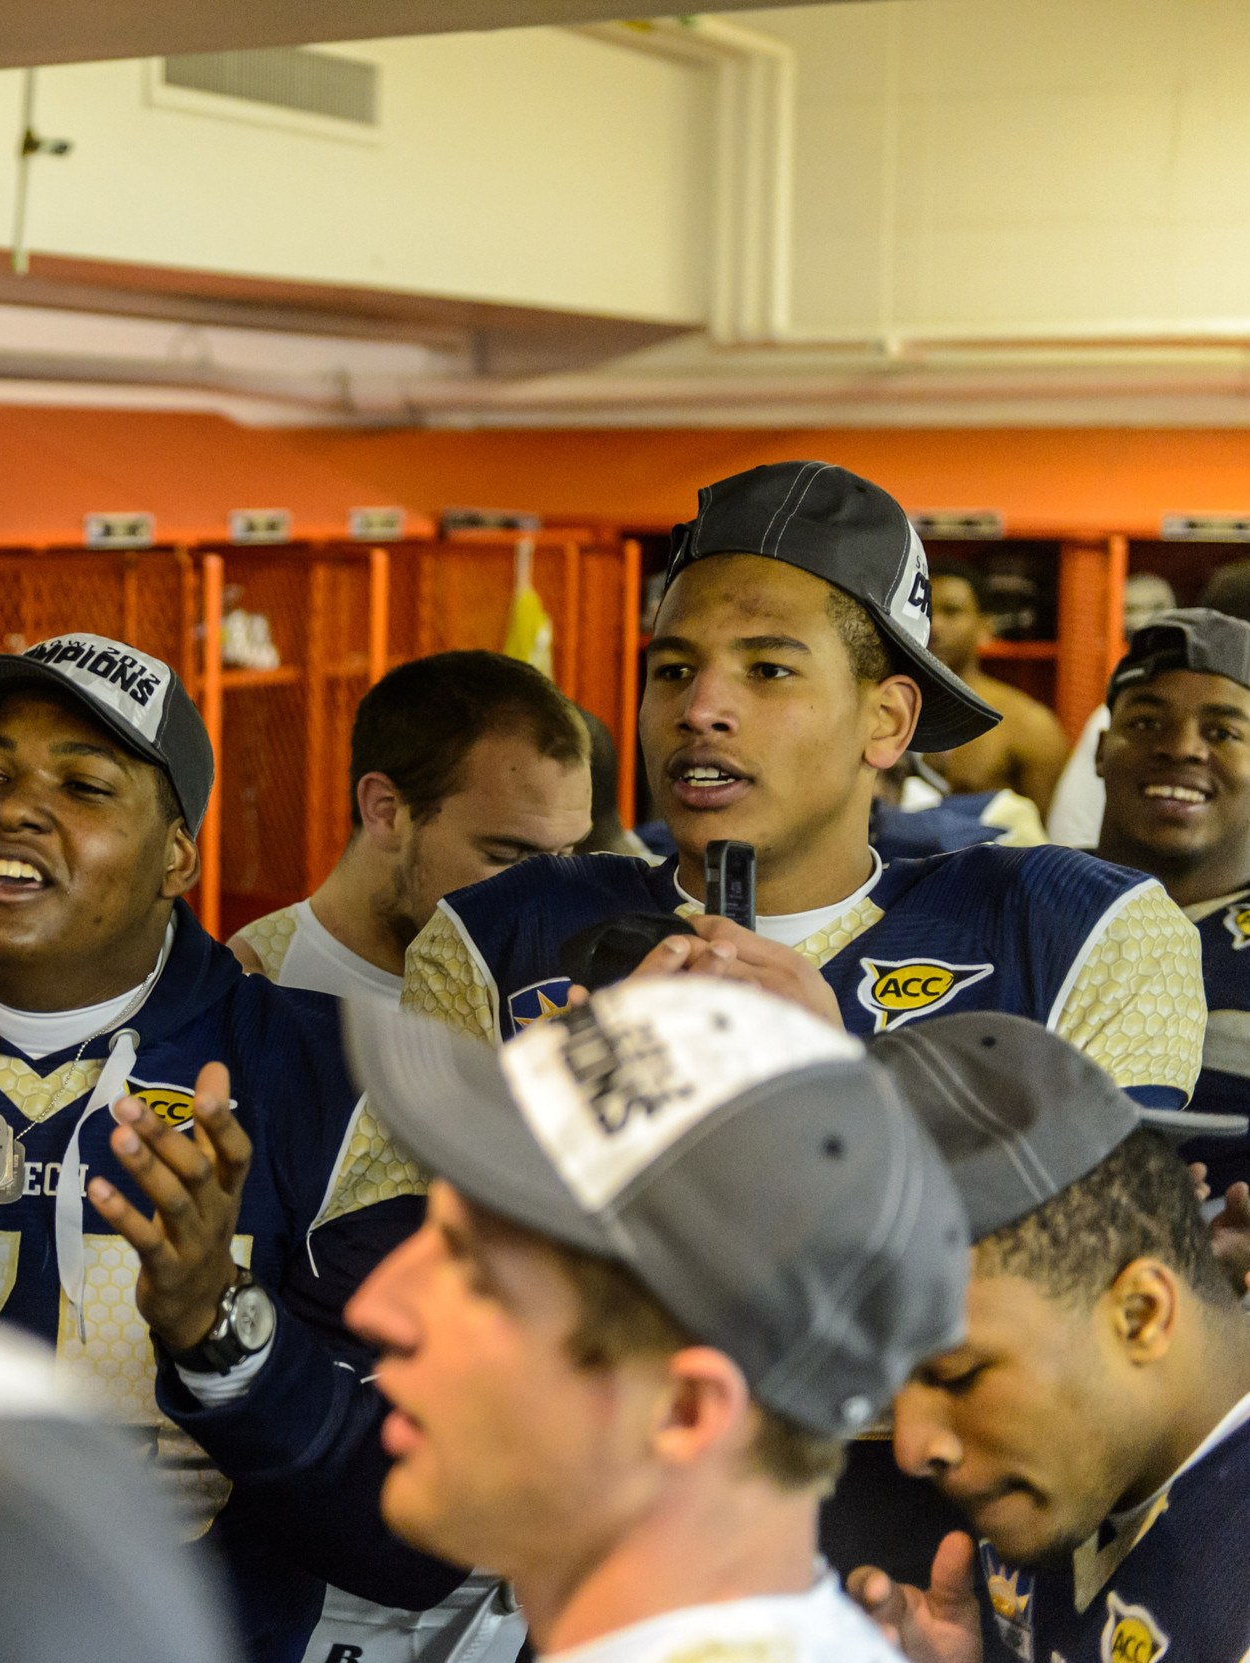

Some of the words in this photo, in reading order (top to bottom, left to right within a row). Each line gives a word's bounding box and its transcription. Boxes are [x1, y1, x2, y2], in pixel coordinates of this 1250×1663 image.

[24, 644, 155, 706] MPIONS
[107, 647, 162, 687] 2012
[878, 977, 943, 998] ACC
[138, 1097, 189, 1120] CC
